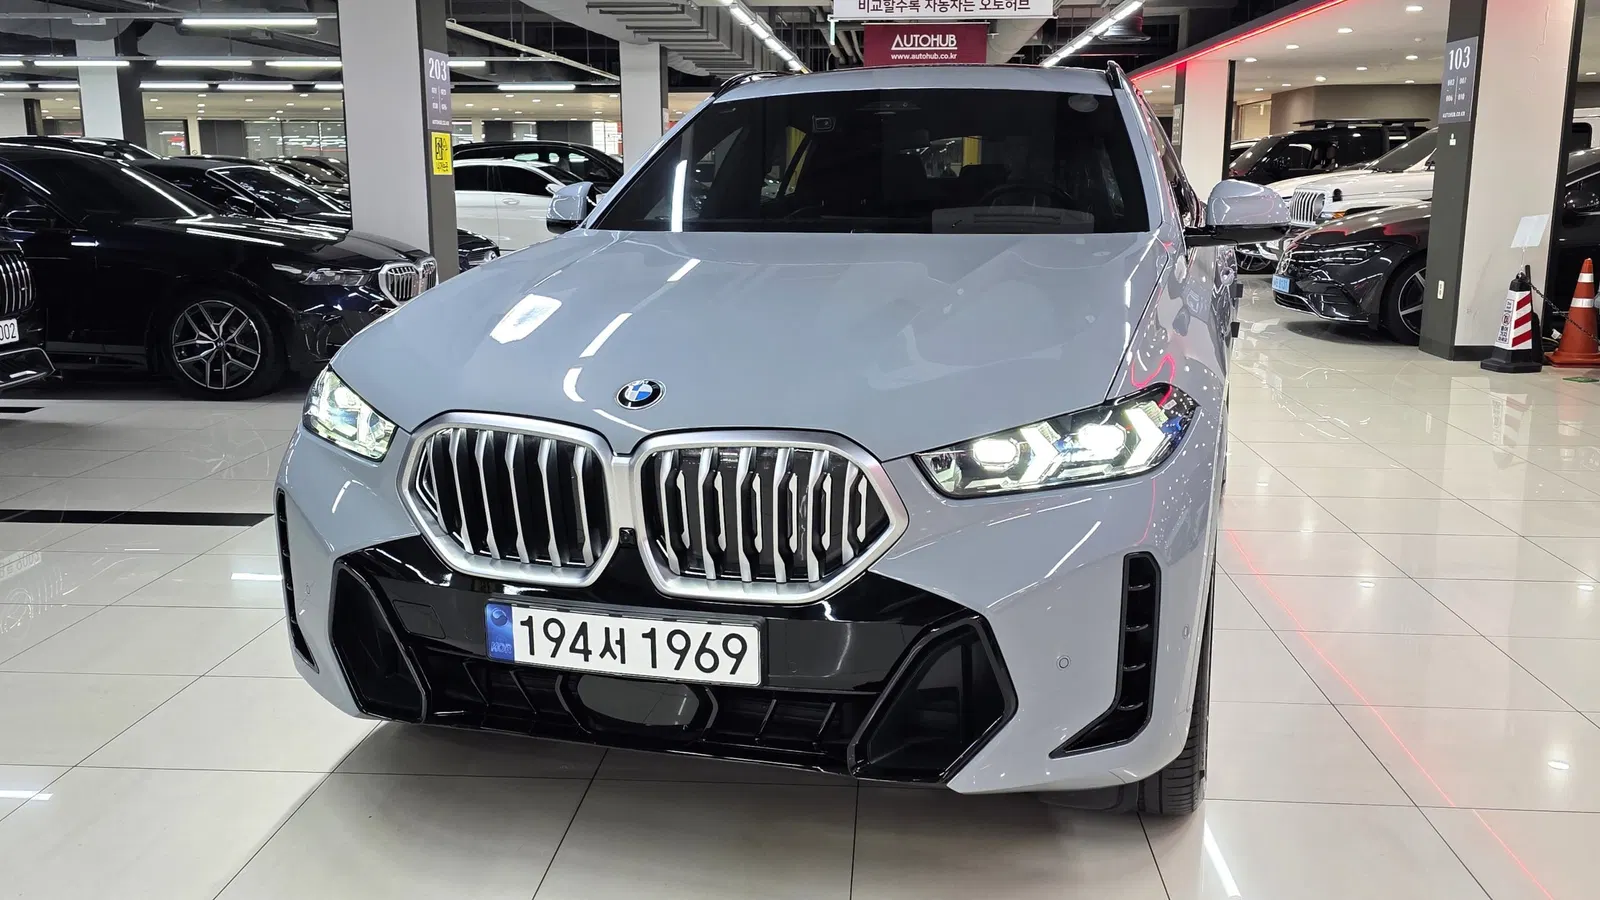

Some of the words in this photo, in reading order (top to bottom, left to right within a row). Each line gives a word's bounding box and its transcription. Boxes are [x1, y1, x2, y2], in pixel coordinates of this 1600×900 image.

[858, 0, 921, 13] 비교할수록
[979, 0, 1031, 11] 오토허브
[891, 34, 957, 50] AUTOHUB
[890, 52, 957, 60] www.autohub.co.kr
[1448, 45, 1471, 71] 103
[428, 57, 447, 81] 203
[520, 615, 626, 664] 194서
[641, 627, 748, 675] 1969
